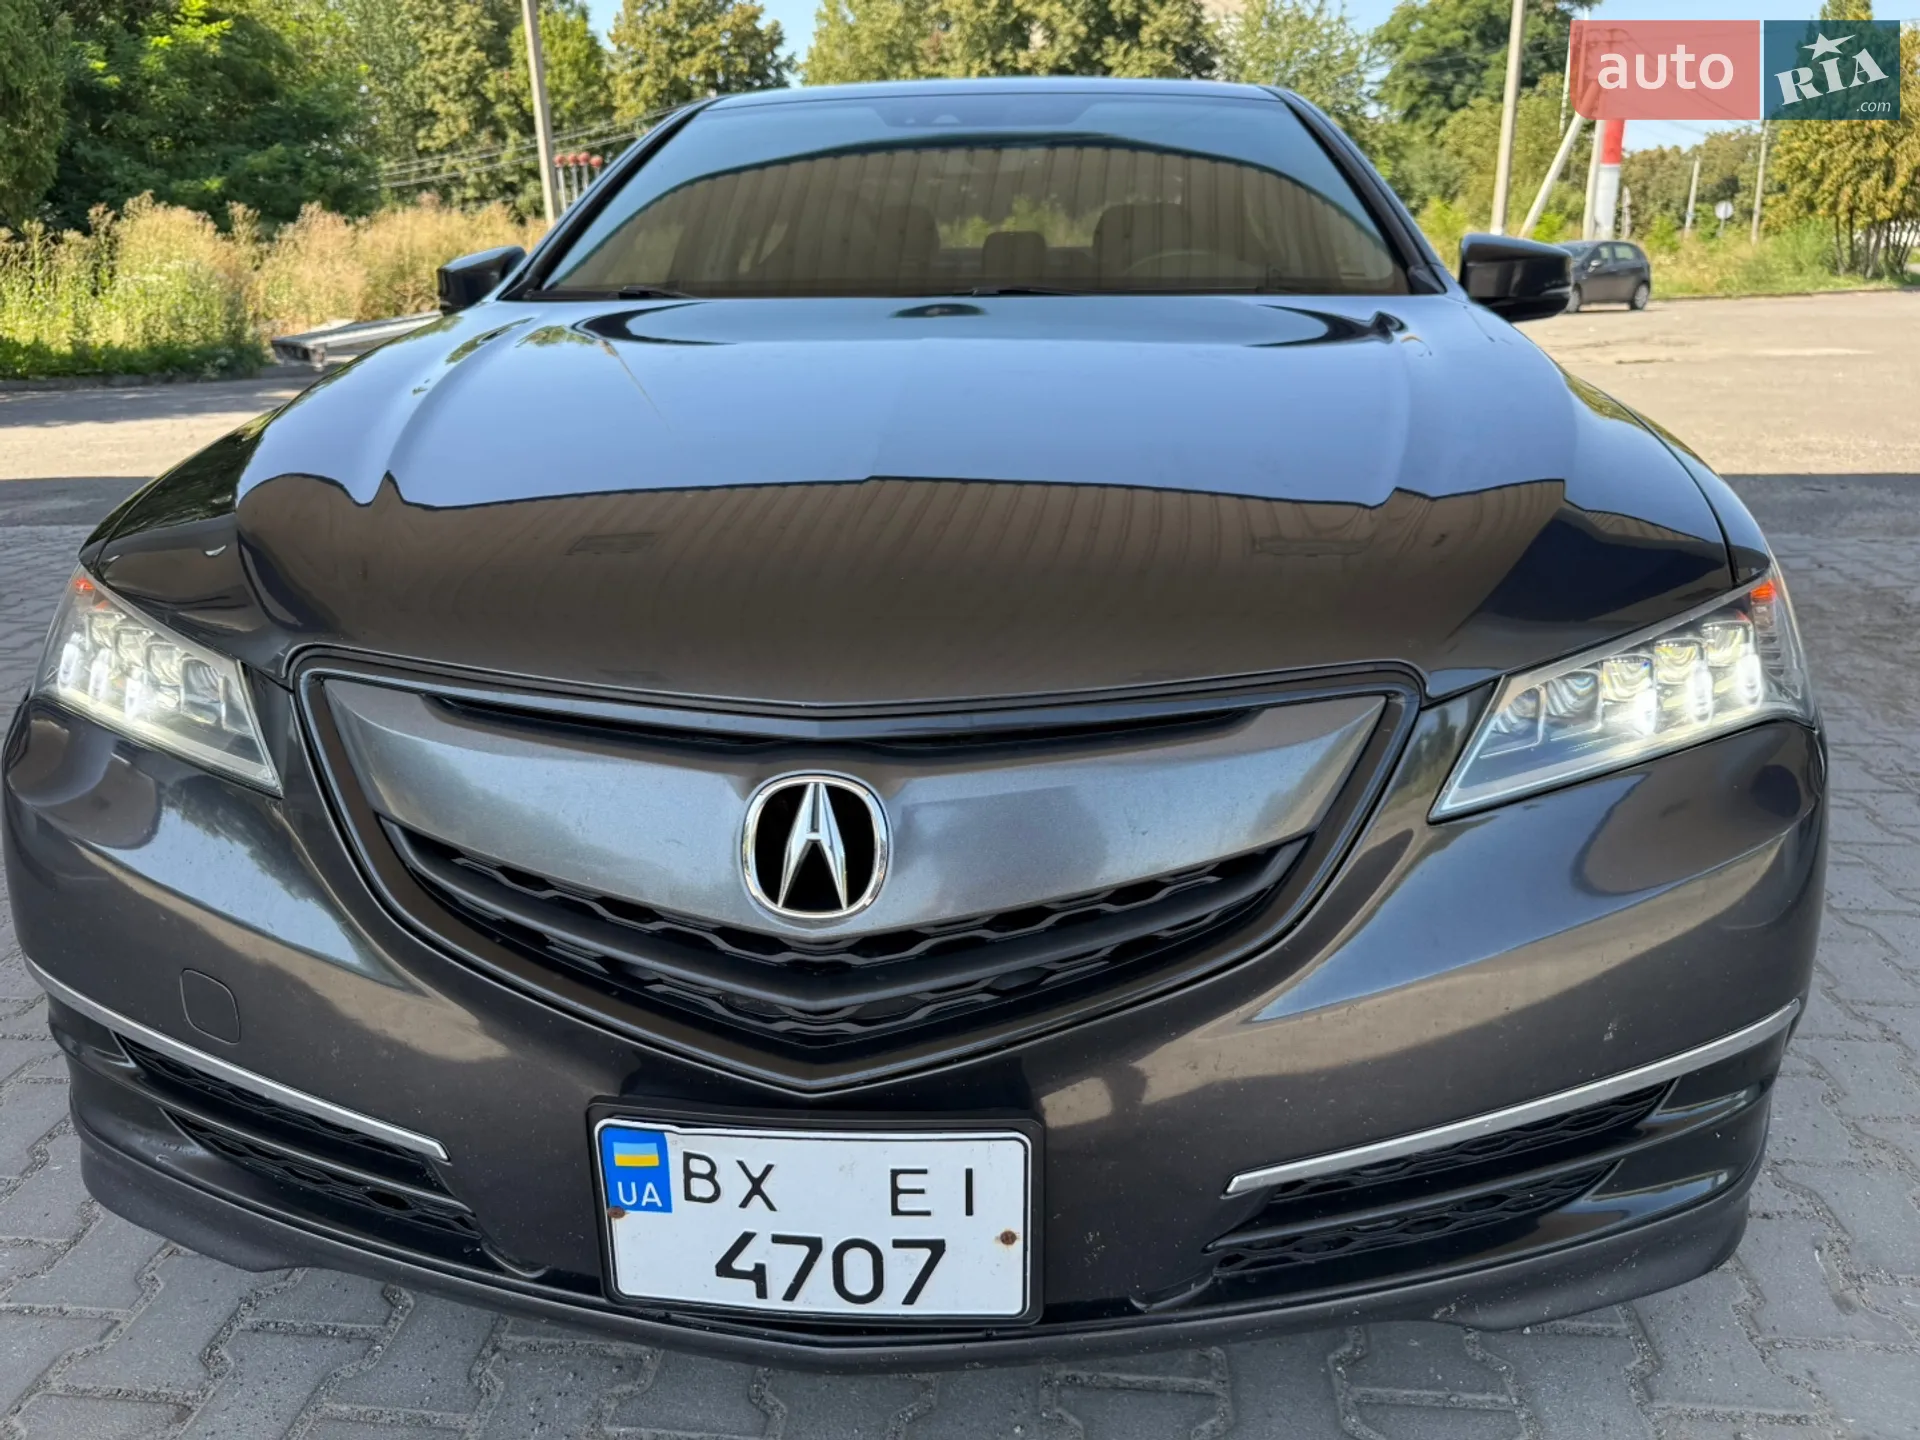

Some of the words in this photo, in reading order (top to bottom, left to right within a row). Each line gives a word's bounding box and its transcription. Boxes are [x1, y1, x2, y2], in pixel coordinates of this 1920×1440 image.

[617, 1181, 662, 1208] UA
[682, 1150, 777, 1212] BX
[889, 1168, 974, 1217] EI
[714, 1230, 946, 1306] 4707
